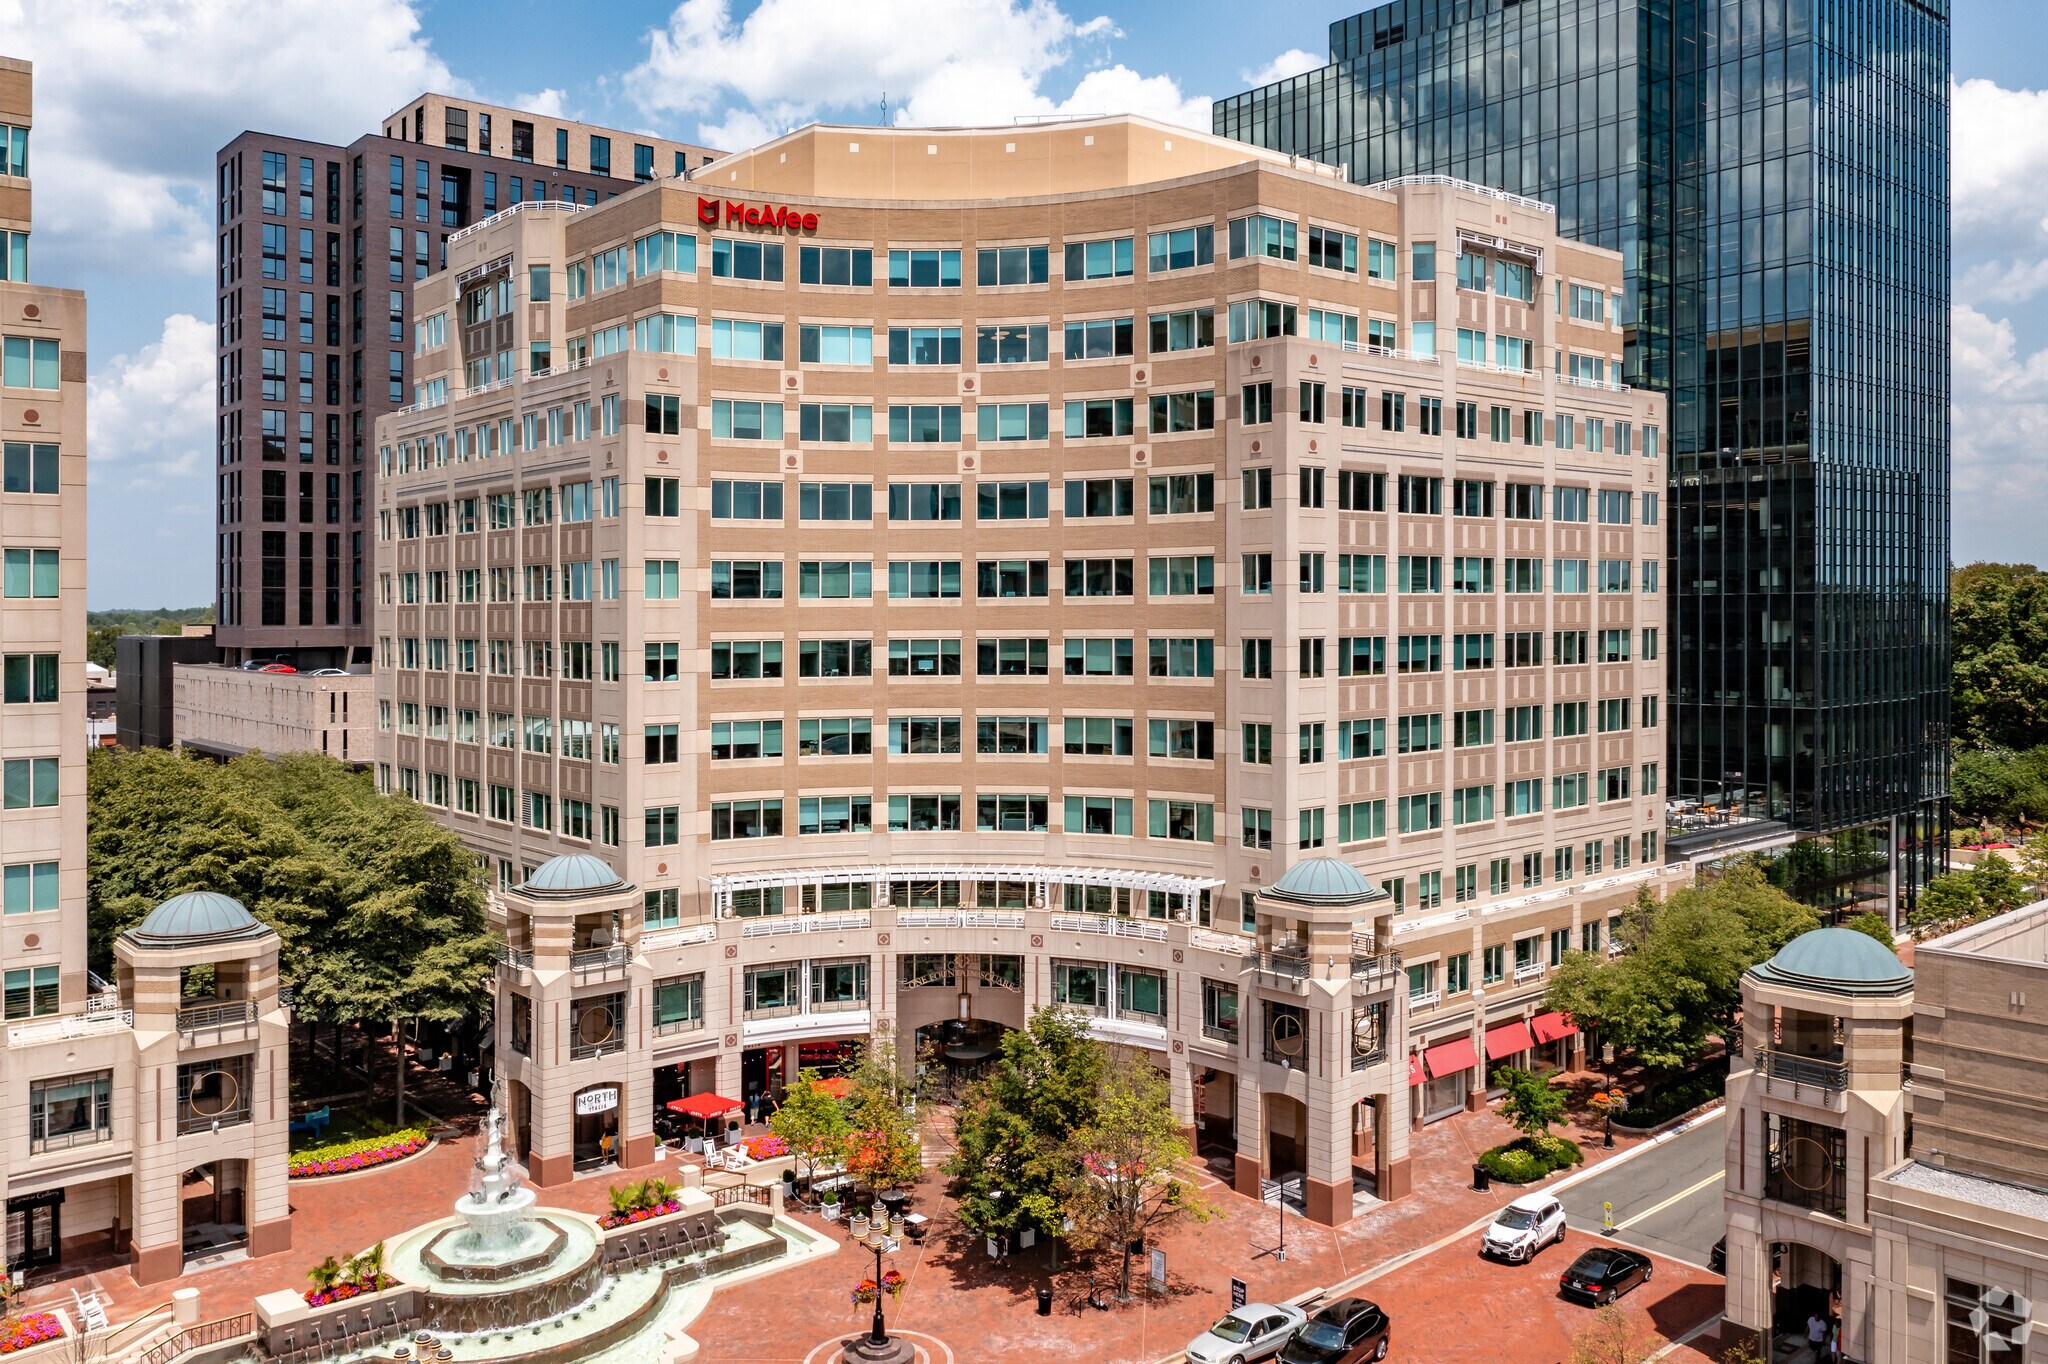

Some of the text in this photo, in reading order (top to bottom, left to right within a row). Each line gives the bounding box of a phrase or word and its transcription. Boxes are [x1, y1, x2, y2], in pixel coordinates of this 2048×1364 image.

[726, 200, 818, 230] McAfee
[909, 977, 927, 989] ONE
[981, 972, 1014, 991] SQUARE
[578, 1090, 616, 1107] NORTH
